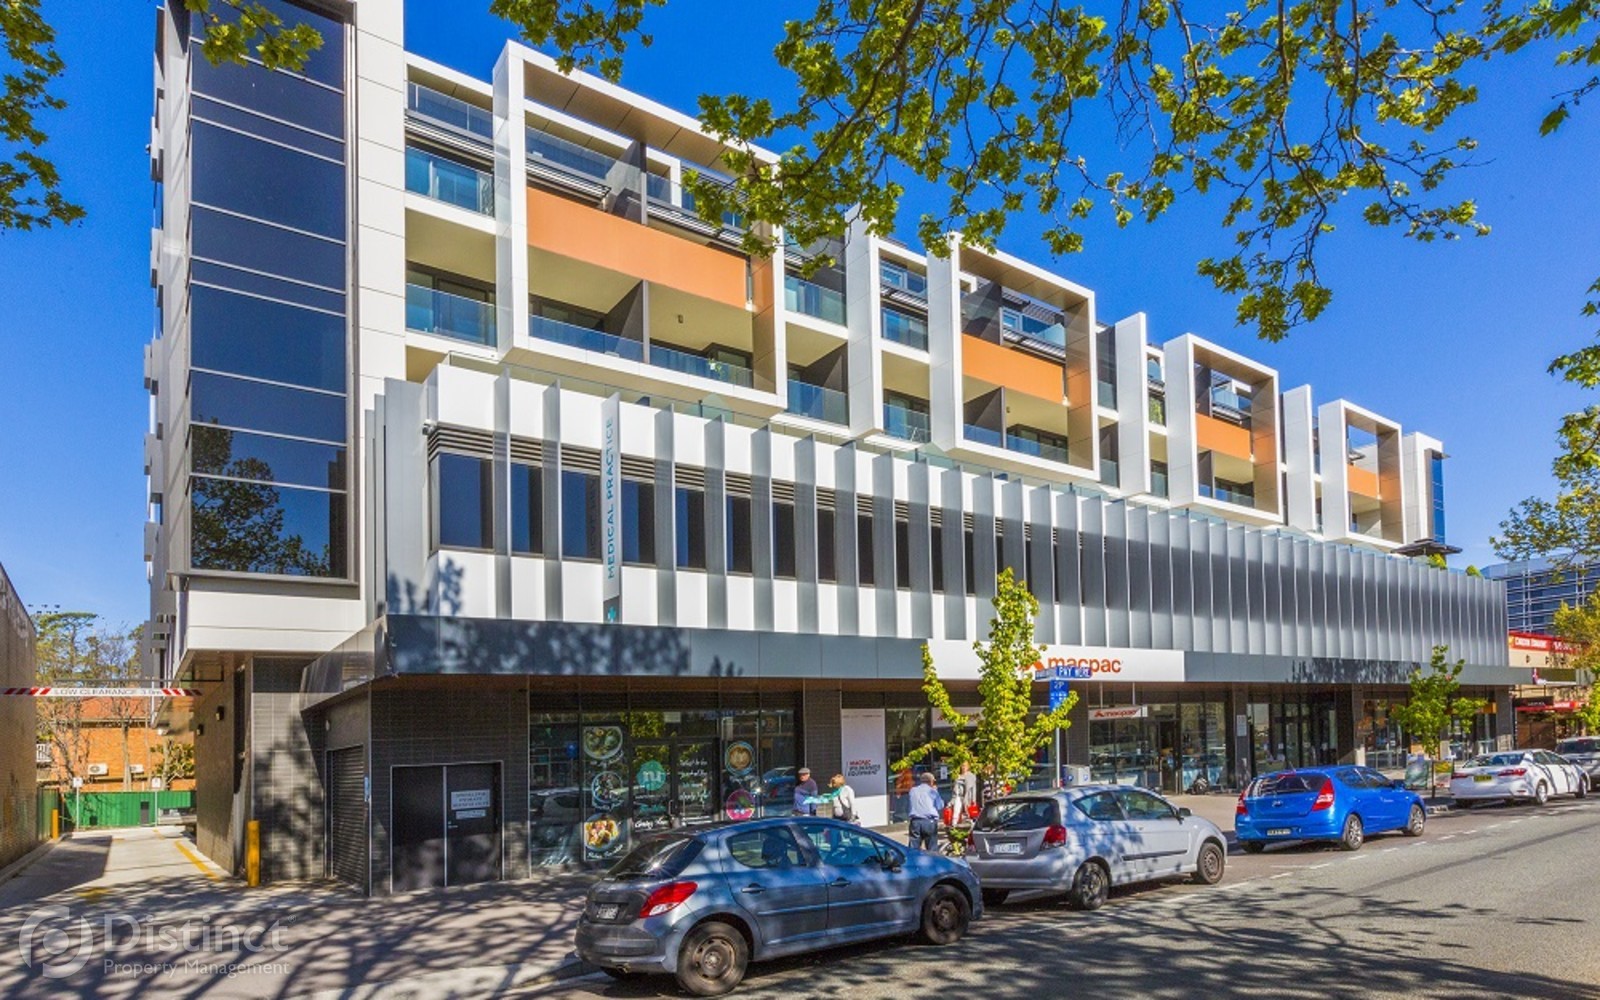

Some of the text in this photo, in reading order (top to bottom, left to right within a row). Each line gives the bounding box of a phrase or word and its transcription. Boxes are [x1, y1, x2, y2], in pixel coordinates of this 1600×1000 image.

[606, 417, 615, 579] MEDICAL PRACTICE
[1047, 656, 1122, 673] macpac
